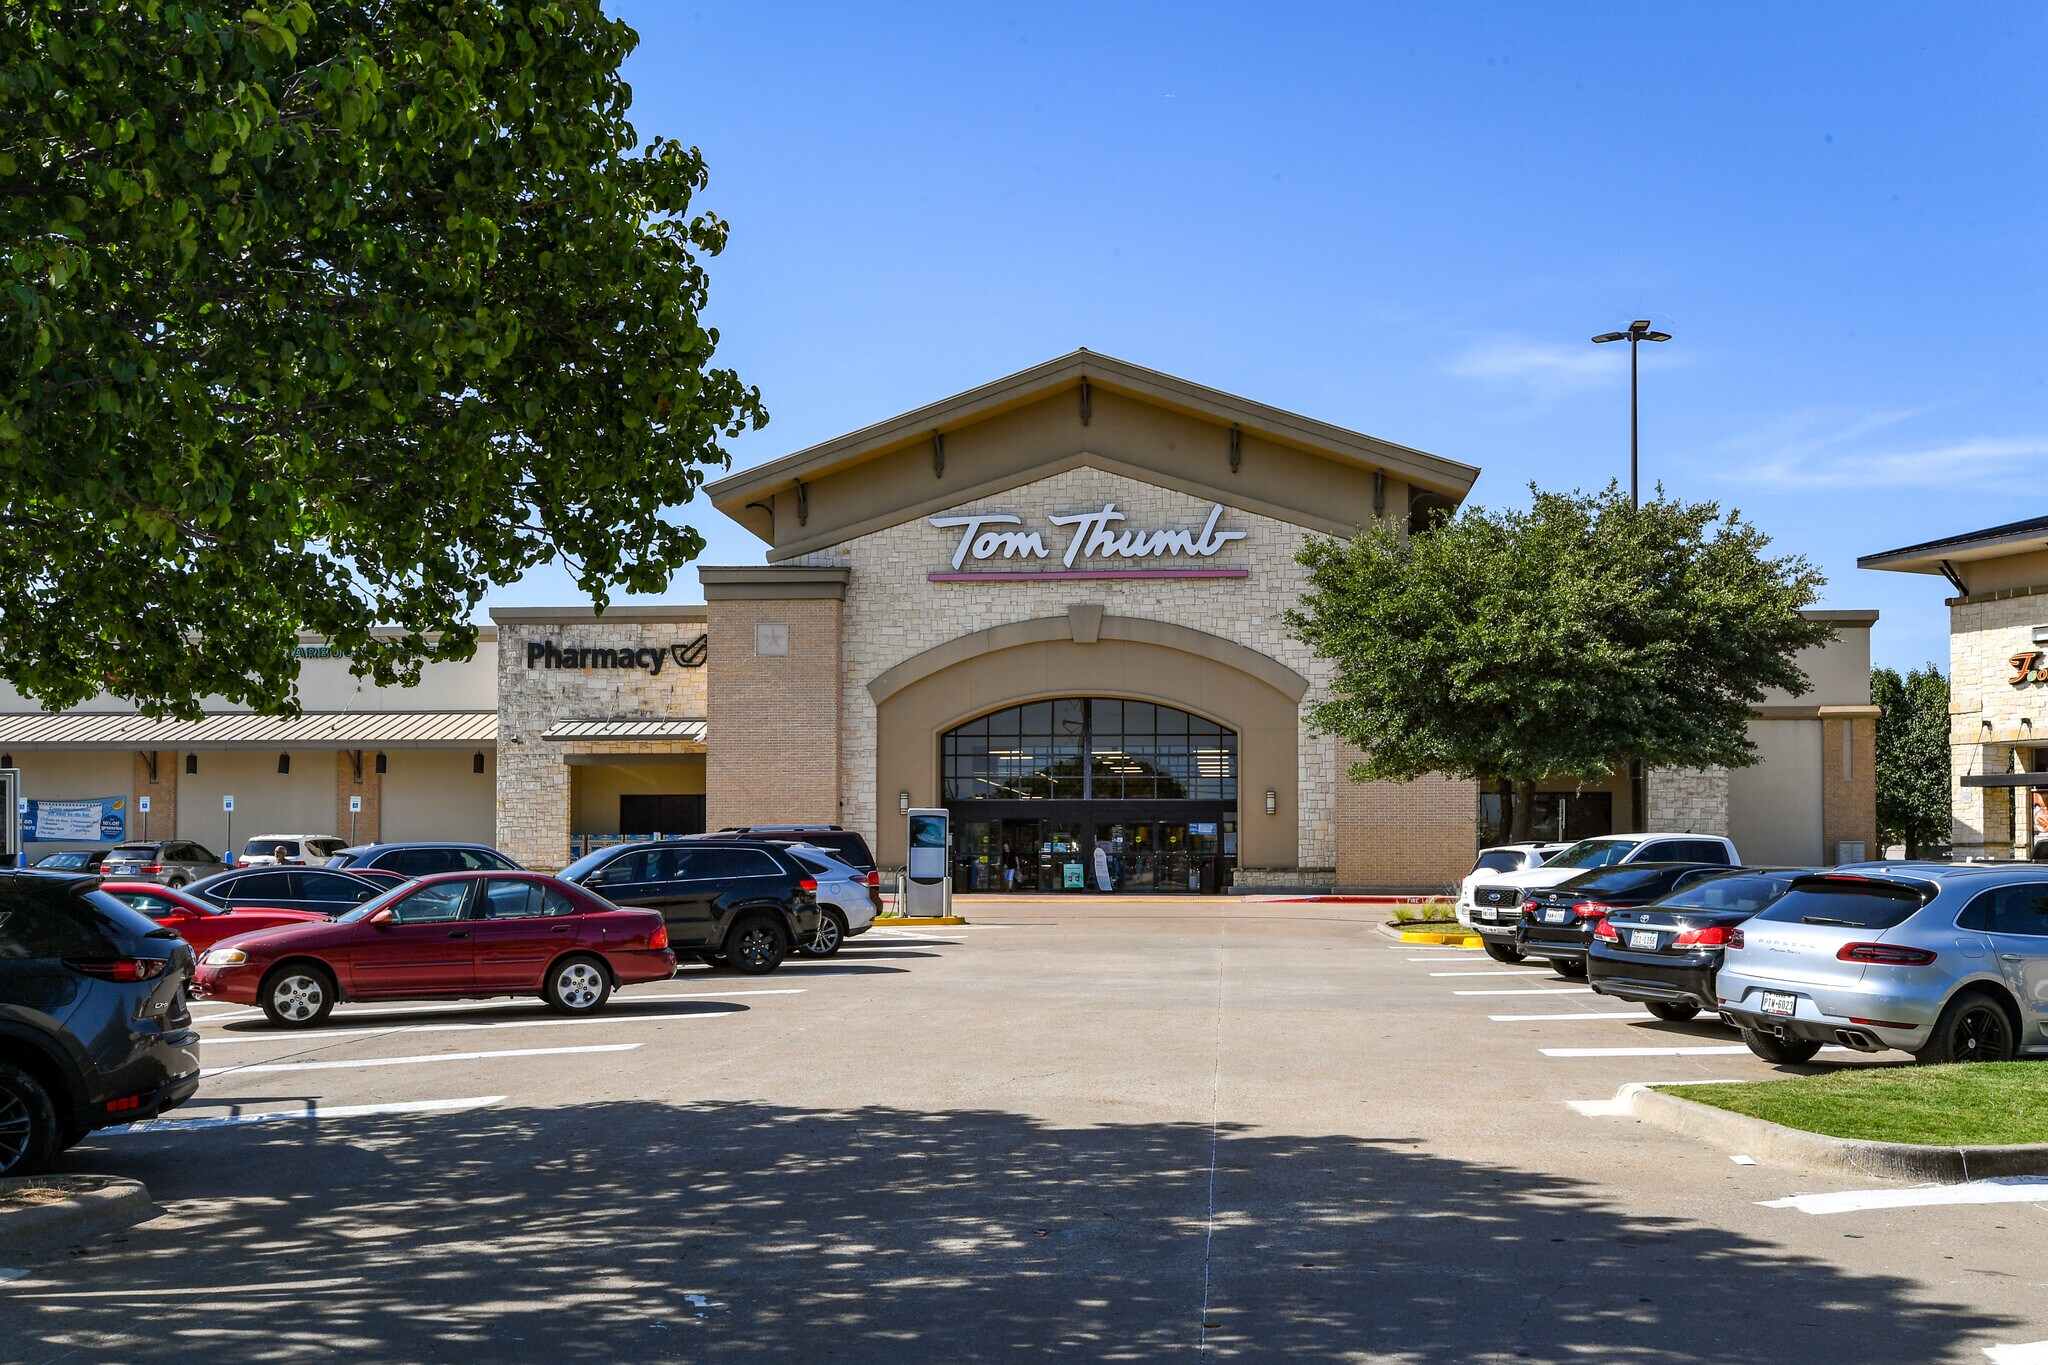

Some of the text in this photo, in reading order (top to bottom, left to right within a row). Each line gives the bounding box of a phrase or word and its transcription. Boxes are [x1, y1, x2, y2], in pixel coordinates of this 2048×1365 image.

[928, 503, 1247, 571] Tom Thumb
[527, 640, 667, 676] Pharmacy
